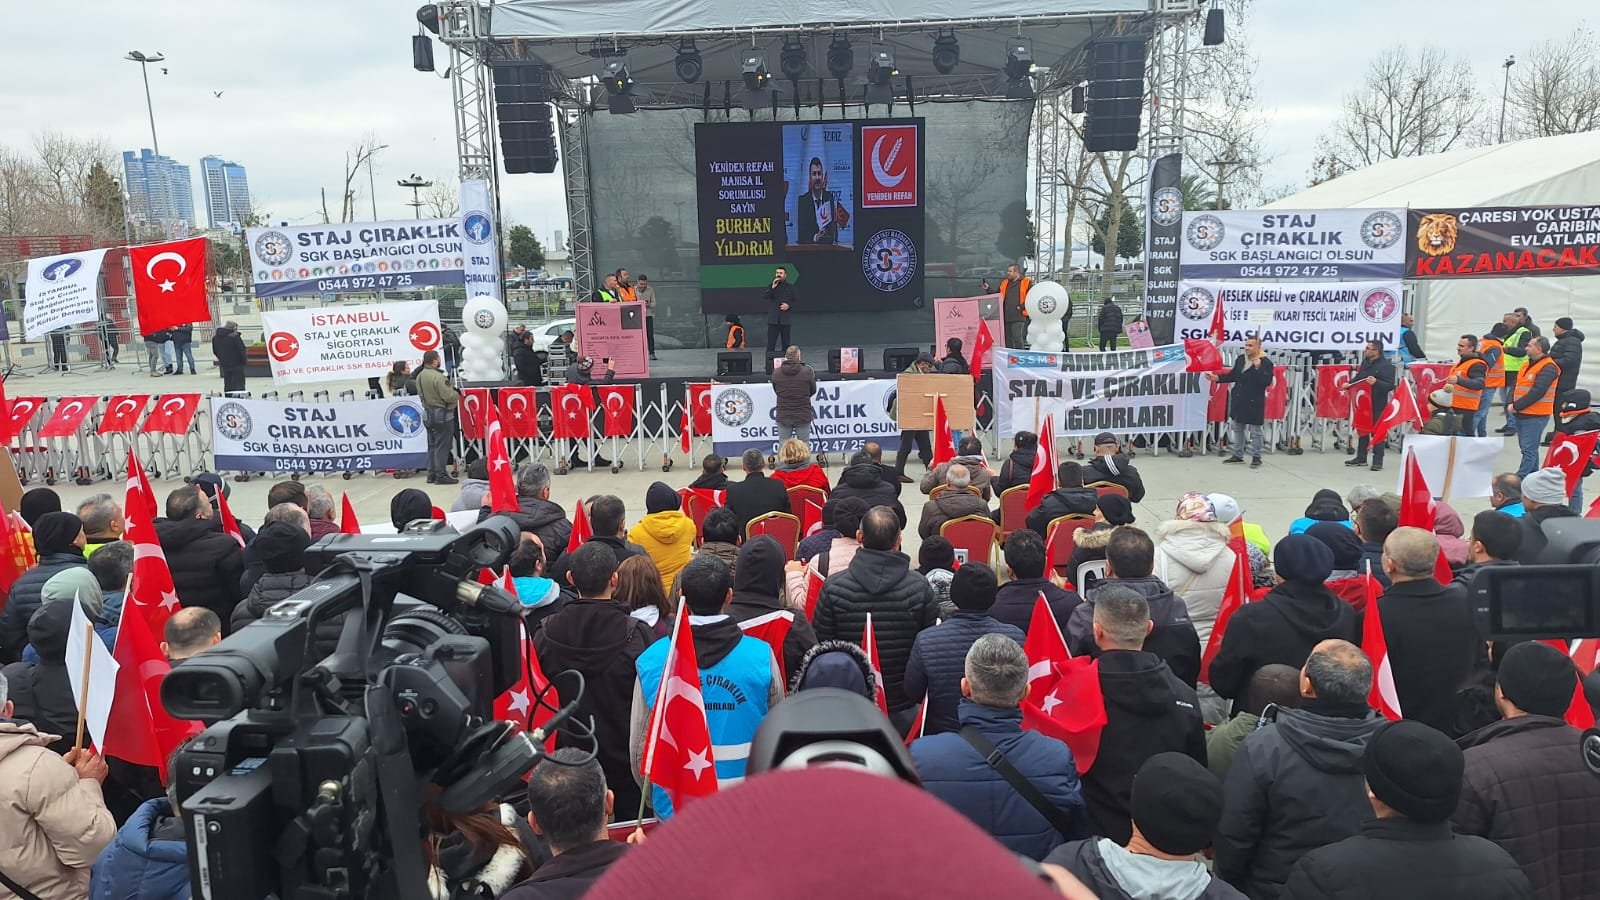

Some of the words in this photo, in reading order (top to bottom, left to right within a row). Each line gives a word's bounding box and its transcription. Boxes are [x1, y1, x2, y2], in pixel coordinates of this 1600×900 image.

[710, 161, 744, 173] YENİDEN
[746, 162, 774, 172] REFAH
[719, 190, 766, 200] SORUMLUSU
[894, 192, 912, 200] REFAH
[1262, 214, 1316, 228] STAJ
[1522, 210, 1556, 222] YOK
[1559, 208, 1600, 220] USTA
[716, 218, 771, 234] BURHAN
[297, 230, 352, 247] STAJ
[359, 224, 460, 247] ÇIRAKLIK
[1154, 236, 1176, 245] STAJ
[1240, 232, 1342, 249] ÇIRAKLIK
[300, 250, 330, 262] SGK
[334, 245, 414, 260] BAŞLANGICI
[418, 242, 462, 254] OLSUN
[1209, 251, 1239, 261] SGK
[1241, 251, 1322, 263] BAŞLANGICI
[1326, 250, 1374, 260] OLSUN
[471, 256, 489, 266] STAJ
[1416, 245, 1600, 276] KAZANACAK
[1240, 266, 1271, 276] 0544
[1276, 266, 1298, 276] 972
[1303, 266, 1318, 276] 47
[1322, 266, 1338, 276] 25
[318, 280, 349, 290] 0544
[353, 278, 375, 288] 972
[379, 276, 393, 286] 47
[397, 275, 412, 285] 25
[1256, 287, 1282, 303] LİSELİ
[1285, 294, 1296, 302] ve
[1299, 290, 1359, 305] ÇIRAKLARIN
[311, 312, 390, 327] İSTANBUL
[1303, 308, 1327, 322] TESCİL
[1329, 308, 1356, 322] TARİHİ
[304, 331, 330, 341] STAJ
[334, 330, 348, 338] VE
[350, 326, 401, 337] ÇIRAKLIK
[1331, 332, 1393, 344] OLSUN
[326, 338, 384, 350] SİGORTASI
[320, 349, 392, 361] MAĞDURLARI
[1061, 351, 1149, 372] ANKARA
[306, 365, 345, 374] ÇIRAKLIK
[1008, 379, 1062, 398] STAJ
[1071, 378, 1096, 399] VE
[1103, 372, 1200, 401] ÇIRAKLIK
[284, 408, 336, 422] STAJ
[1065, 405, 1173, 431] ĞDURLARI
[267, 424, 369, 442] ÇIRAKLIK
[740, 426, 768, 438] SGK
[853, 423, 897, 434] OLSUN
[243, 442, 269, 453] SGK
[273, 443, 352, 456] BAŞLANGICI
[357, 440, 403, 451] OLSUN
[833, 440, 847, 450] 47
[851, 440, 866, 450] 25
[276, 459, 306, 470] 0544
[309, 459, 332, 470] 972
[337, 458, 351, 469] 47
[356, 457, 372, 468] 25
[706, 675, 747, 705] ÇIRAKLIK
